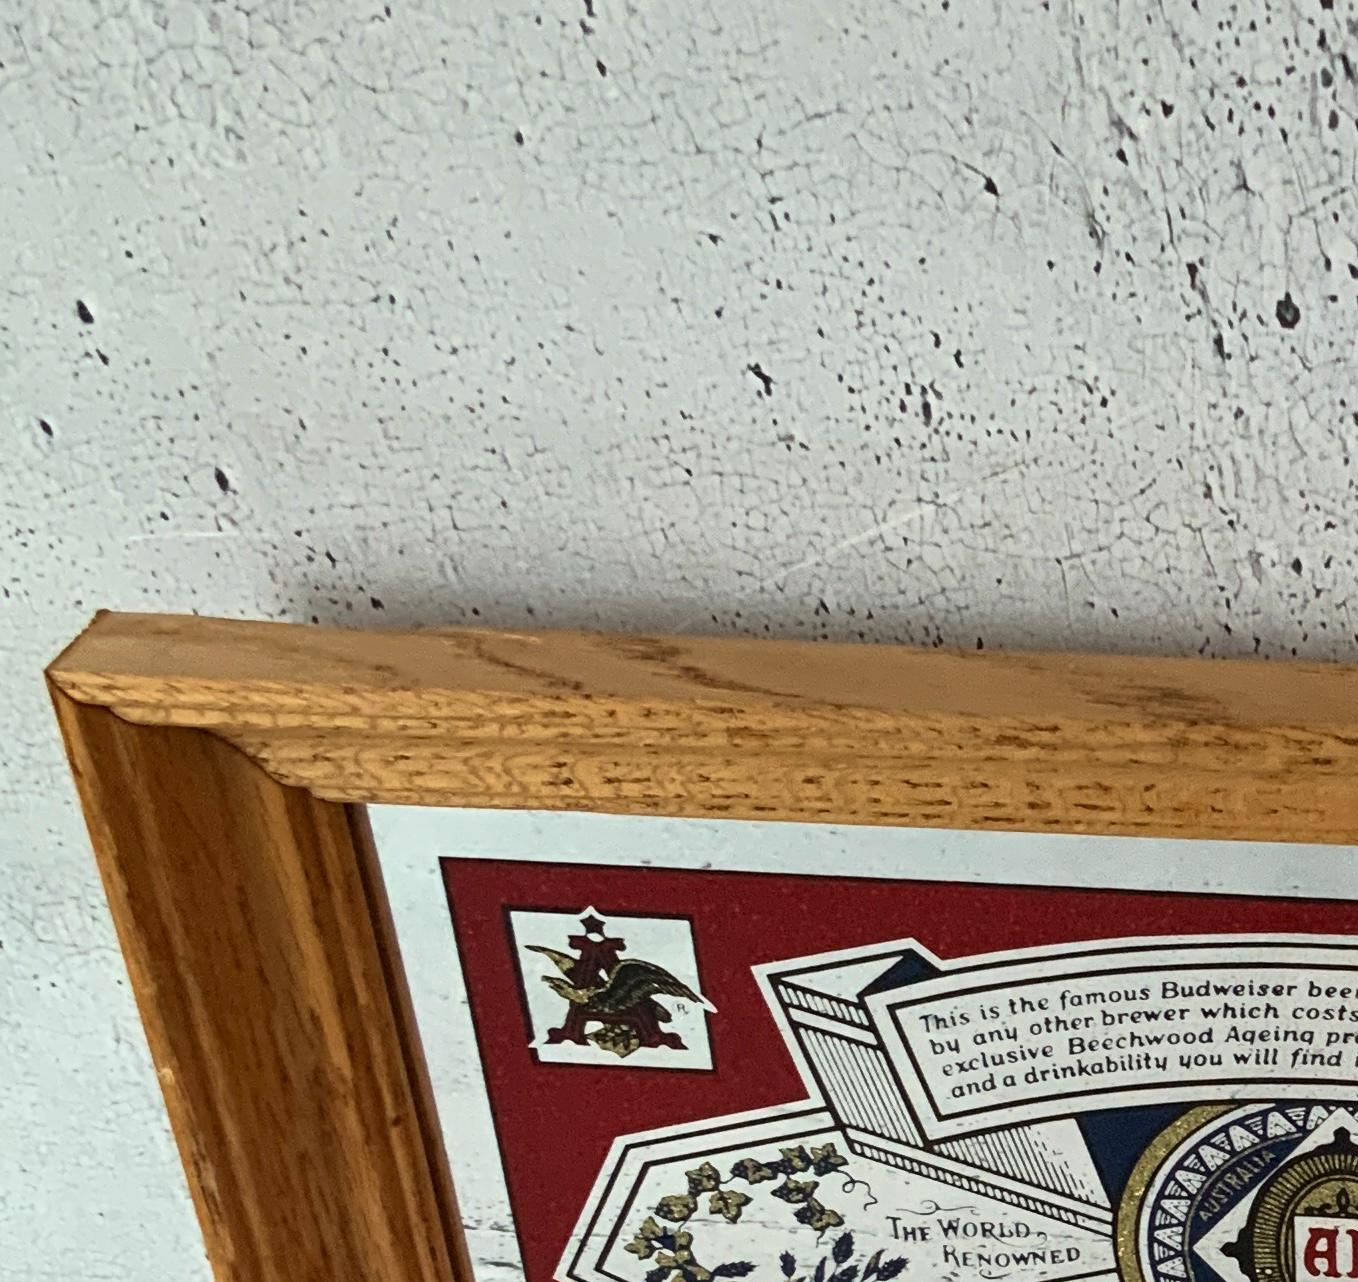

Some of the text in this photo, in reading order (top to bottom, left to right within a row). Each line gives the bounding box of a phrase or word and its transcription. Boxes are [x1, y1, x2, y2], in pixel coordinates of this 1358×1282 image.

[919, 1011, 970, 1034] This
[980, 1004, 1000, 1021] is
[1008, 997, 1049, 1015] the
[1059, 984, 1150, 1010] famous
[1161, 980, 1297, 999] Budweiser
[930, 1038, 959, 1056] by
[973, 1027, 1018, 1047] any
[1029, 1012, 1095, 1036] other
[1102, 1006, 1190, 1027] brewer
[1201, 1002, 1279, 1020] which
[941, 1044, 1054, 1078] exclusive
[1068, 1027, 1213, 1056] Beechwood
[951, 1074, 998, 1099] and
[1002, 1073, 1017, 1088] a
[1024, 1050, 1168, 1085] drinkability
[1178, 1050, 1223, 1069] you
[1233, 1048, 1279, 1065] will
[1290, 1047, 1343, 1069] find
[1199, 1149, 1277, 1222] AUSTRALIA
[937, 1217, 1047, 1248] WORLD
[943, 1244, 1081, 1270] RENOWNED
